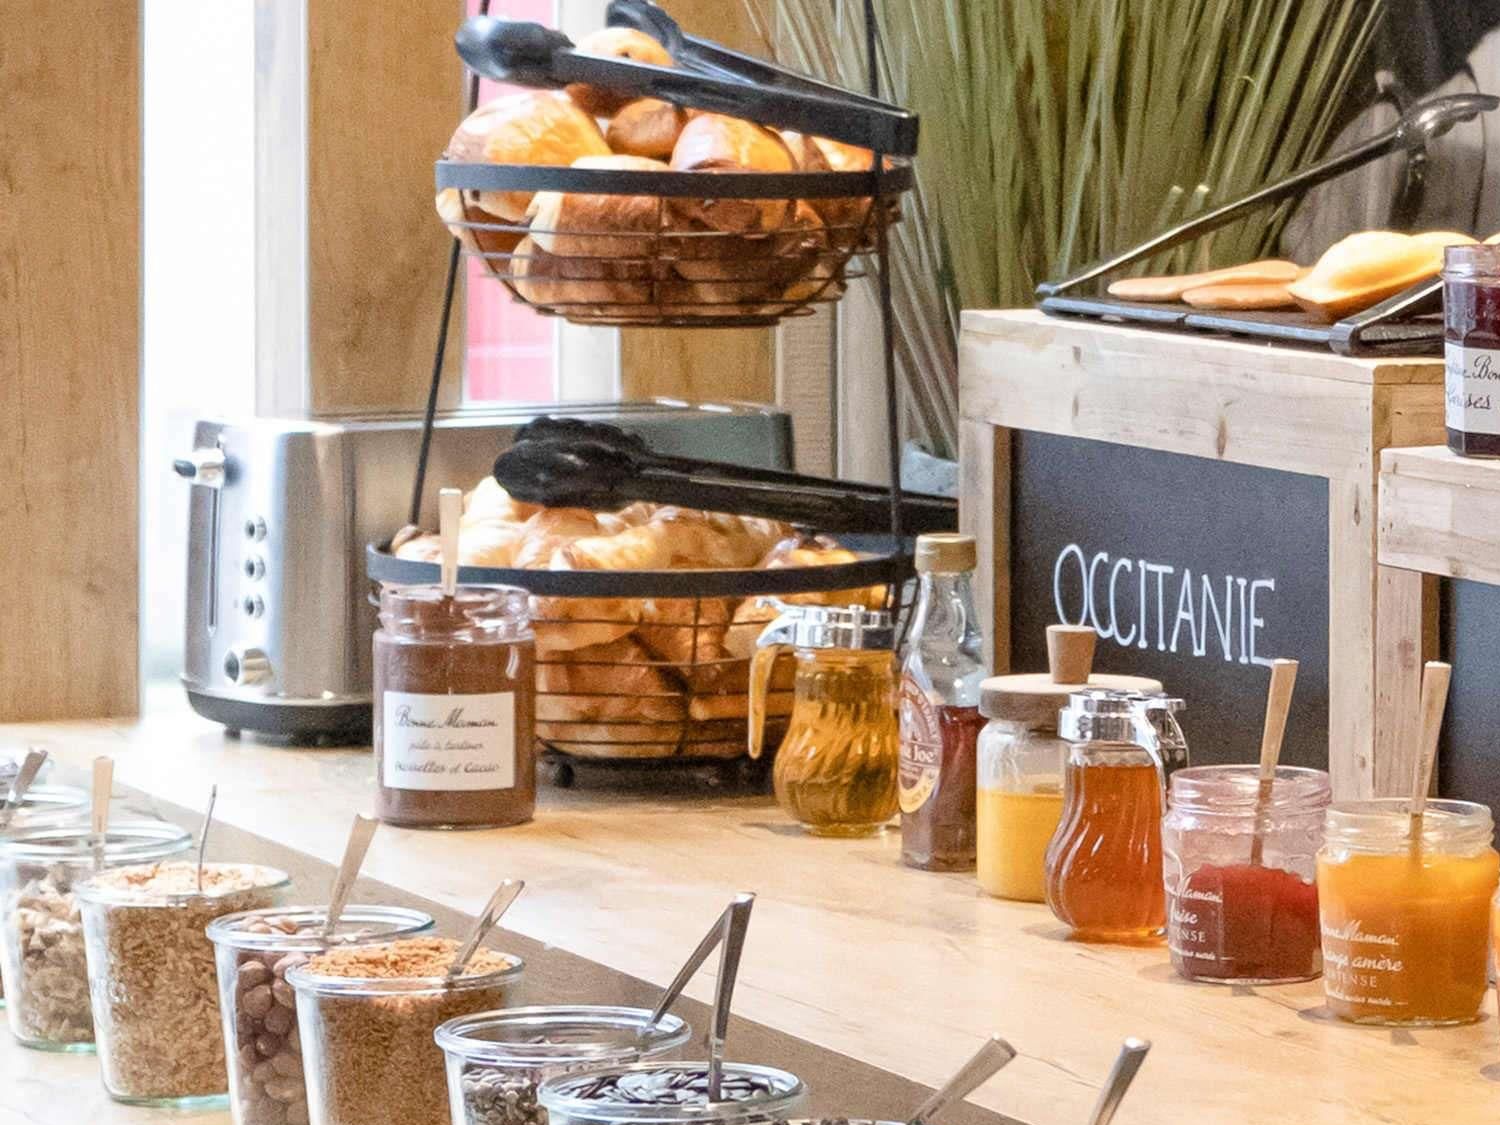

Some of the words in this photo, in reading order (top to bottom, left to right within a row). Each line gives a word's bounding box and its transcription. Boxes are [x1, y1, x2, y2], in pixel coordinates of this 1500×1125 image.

[1054, 543, 1275, 667] OCCITANIE
[395, 704, 438, 729] Bonne
[438, 707, 499, 729] Maman
[1351, 951, 1404, 972] amère
